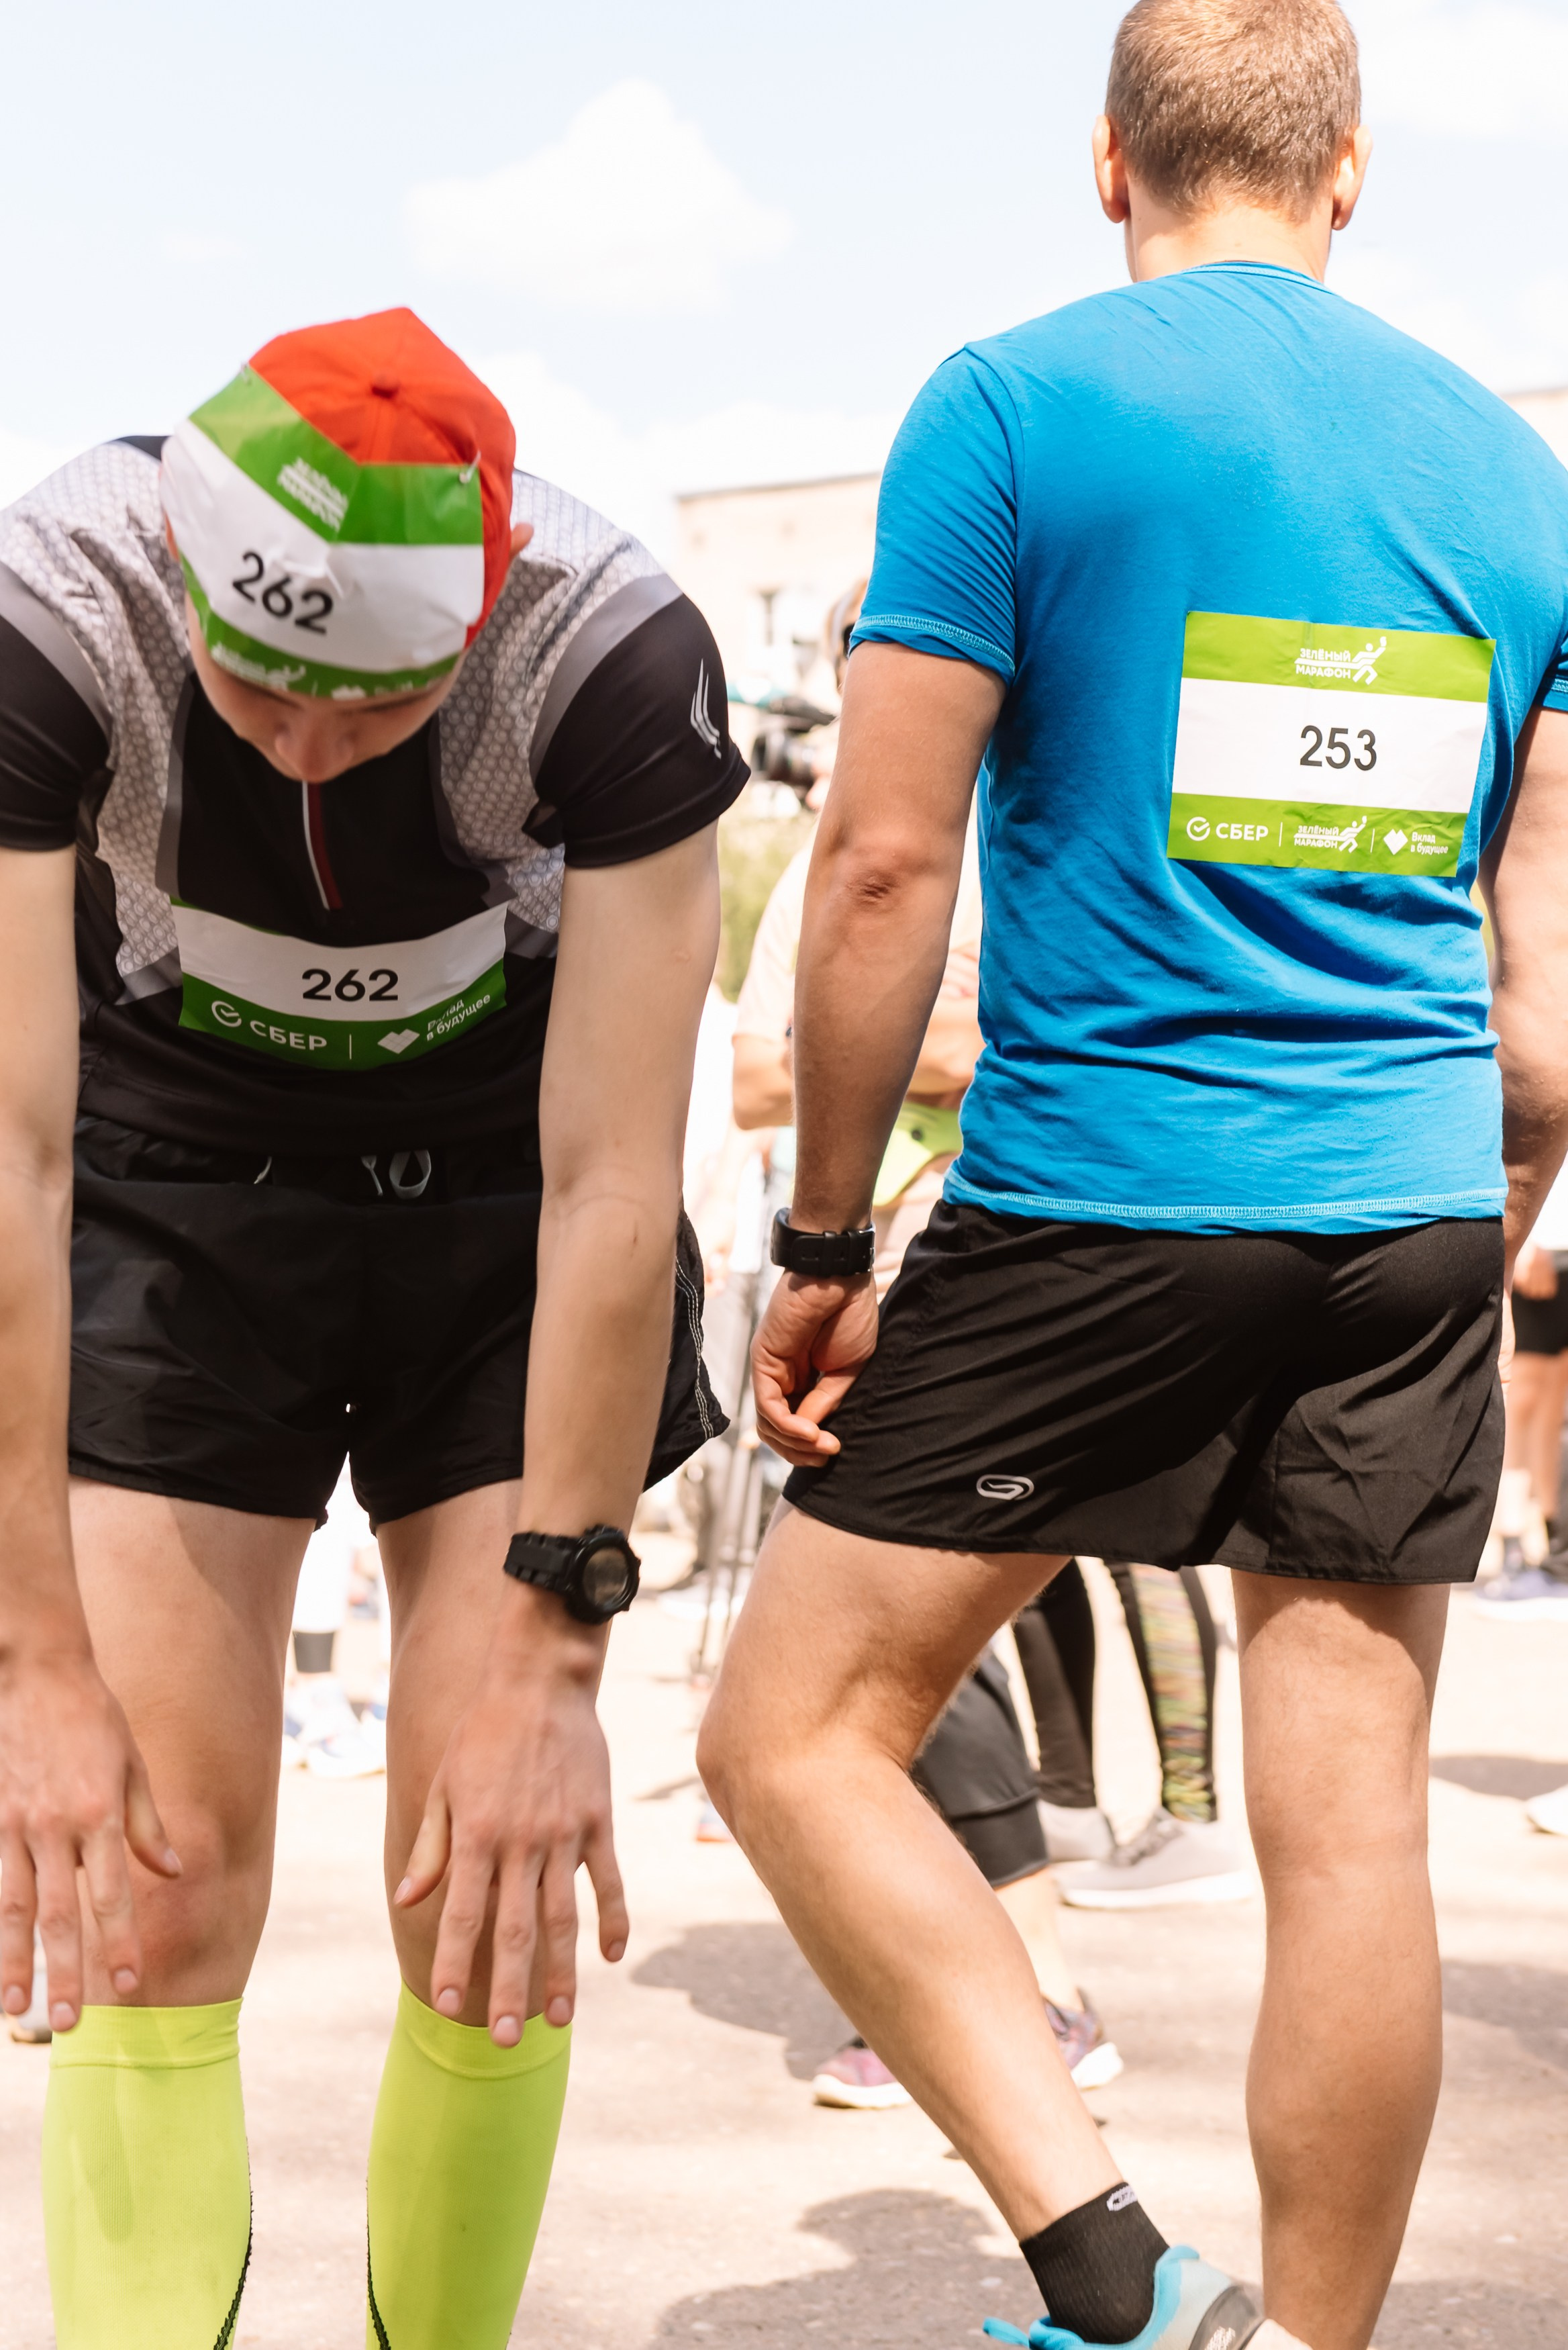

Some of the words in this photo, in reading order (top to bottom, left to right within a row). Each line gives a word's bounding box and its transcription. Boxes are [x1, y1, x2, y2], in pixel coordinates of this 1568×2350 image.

[233, 551, 334, 635] 262
[1300, 648, 1351, 663] ЗЕЛЁНЫЙ
[1295, 664, 1351, 679] МАРАФОН
[1300, 724, 1377, 771] 253
[1216, 822, 1269, 841] СБЕР
[1297, 825, 1340, 837] ЗЕЛЁНЫЙ
[1412, 831, 1436, 844] Вклад
[1294, 838, 1338, 849] МАРАФОН
[1410, 844, 1416, 853] в
[1416, 842, 1449, 855] будущее
[301, 968, 399, 1002] 262
[426, 1031, 434, 1041] в
[436, 994, 491, 1035] будущее
[250, 1020, 328, 1051] СБЕР
